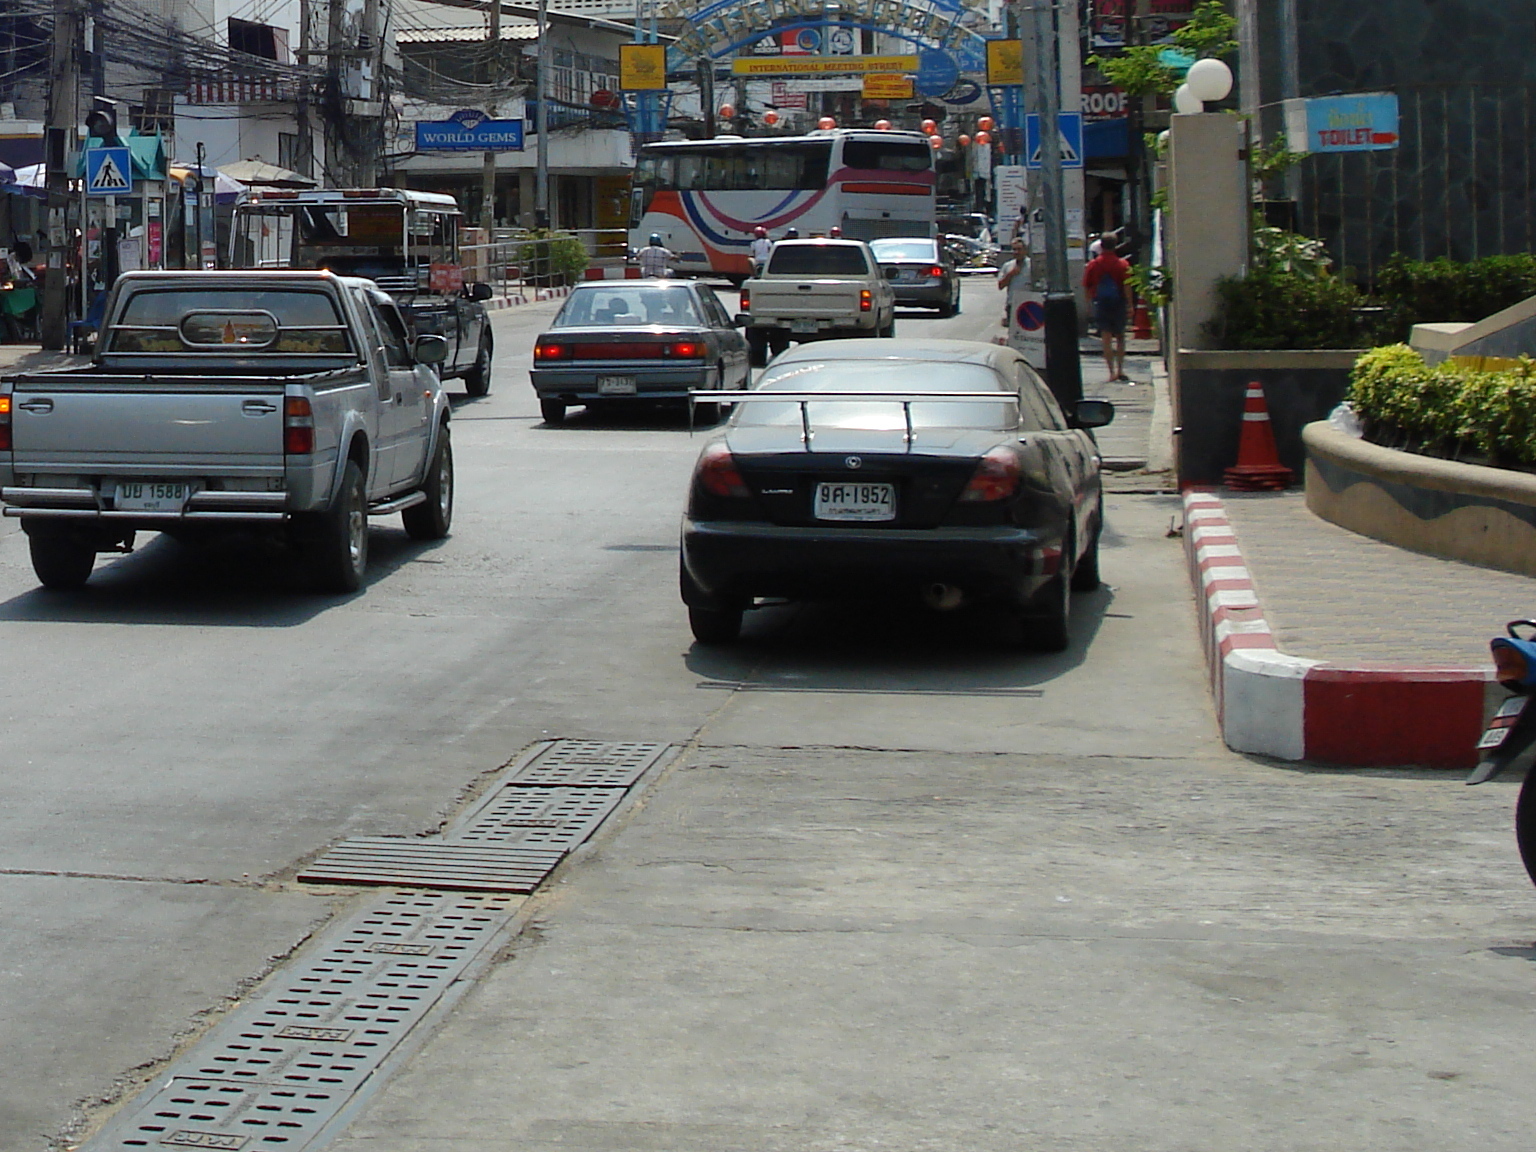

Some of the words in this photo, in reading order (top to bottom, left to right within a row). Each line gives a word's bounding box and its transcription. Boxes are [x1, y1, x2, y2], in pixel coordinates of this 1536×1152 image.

[749, 63, 820, 73] INTERNATIONAL
[867, 60, 904, 71] STREET
[423, 132, 475, 143] WORLD
[477, 132, 517, 143] GEMS
[1318, 127, 1372, 147] TOILET
[149, 485, 182, 498] 1588
